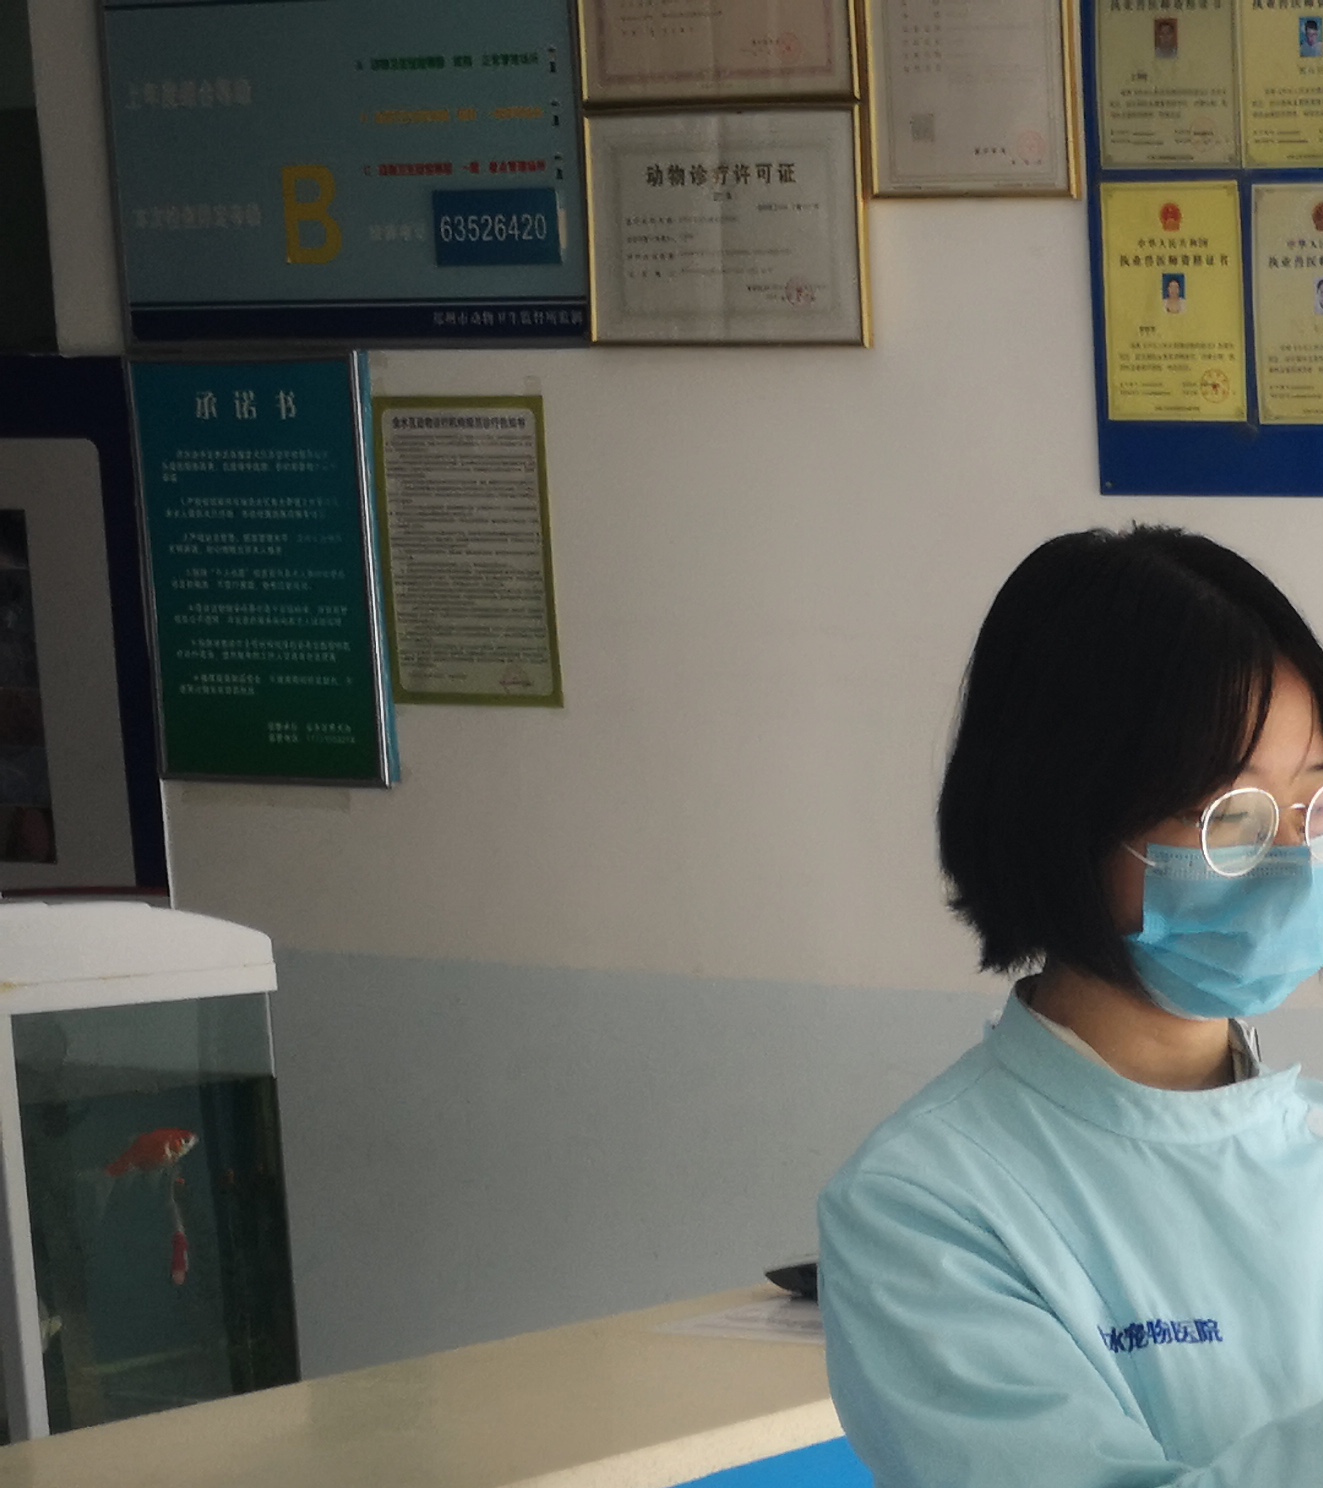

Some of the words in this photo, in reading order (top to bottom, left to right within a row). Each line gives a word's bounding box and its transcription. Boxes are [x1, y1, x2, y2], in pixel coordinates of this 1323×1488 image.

[645, 162, 797, 187] 动物诊疗许可证
[280, 164, 343, 265] B
[439, 213, 548, 242] 63526420
[1119, 254, 1230, 267] 执业兽医师资格证书
[195, 389, 299, 421] 承诺书
